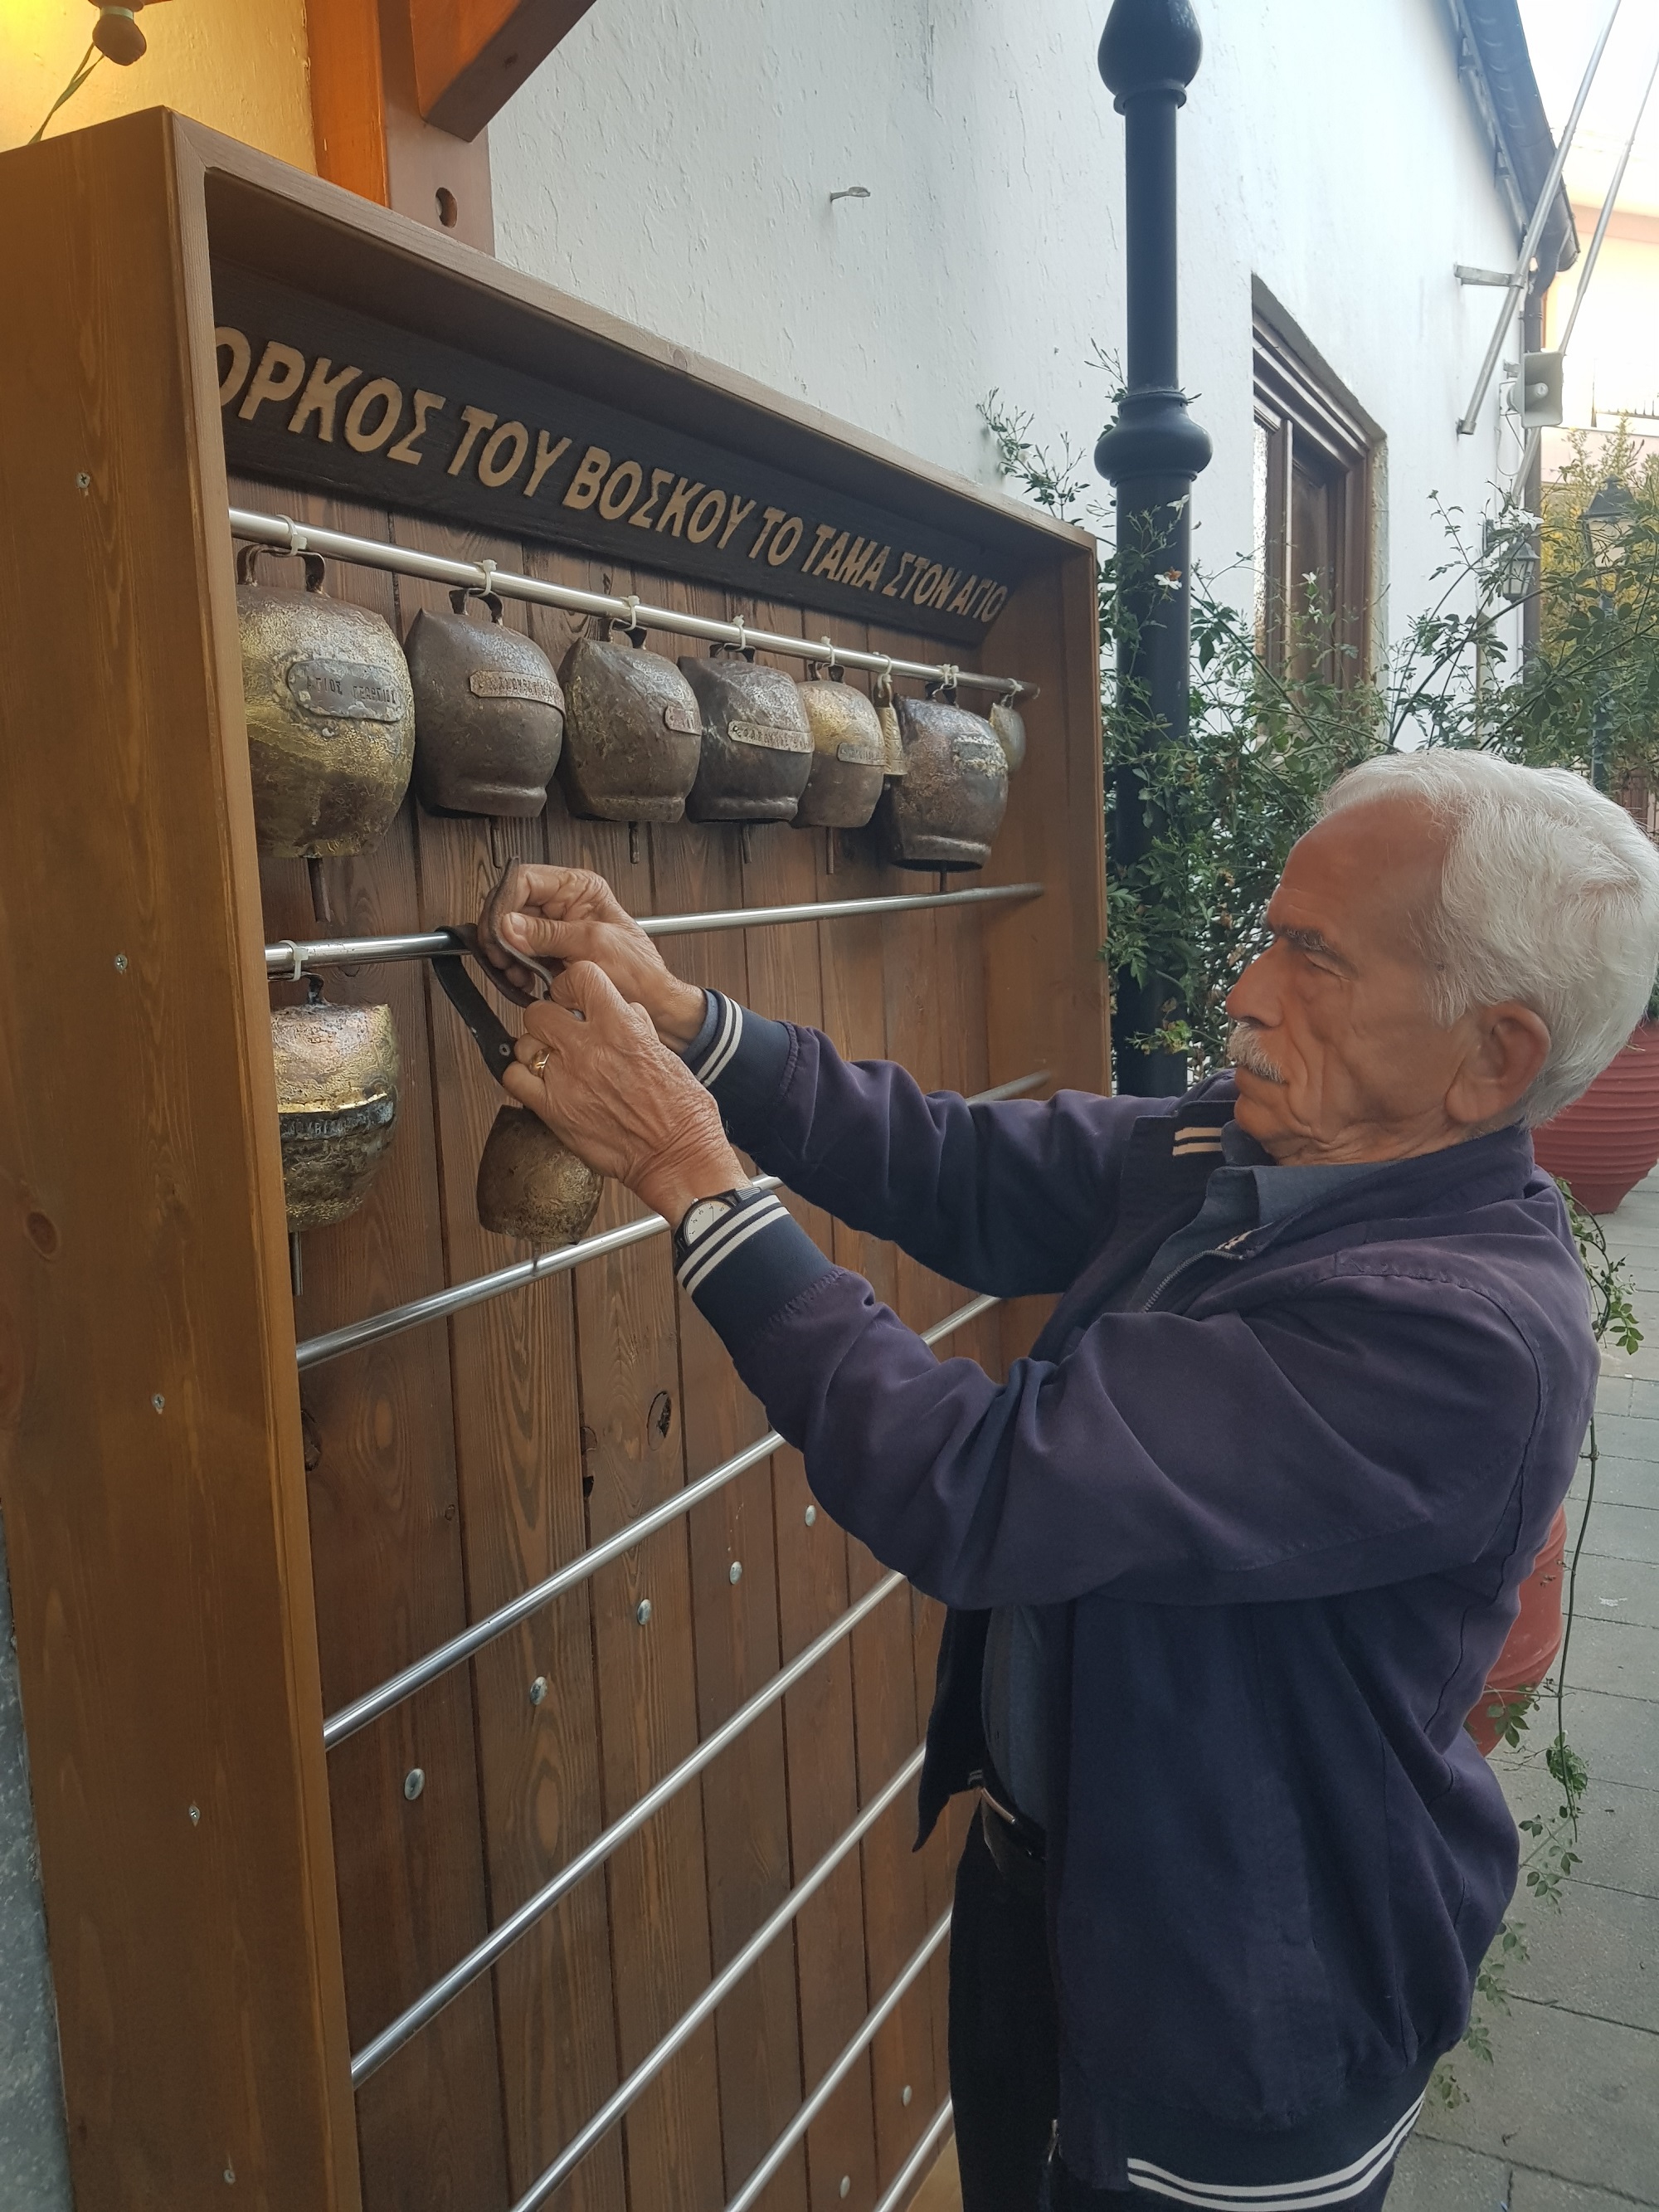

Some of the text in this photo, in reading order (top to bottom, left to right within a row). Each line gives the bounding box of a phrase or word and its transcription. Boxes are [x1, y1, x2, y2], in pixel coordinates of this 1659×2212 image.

[214, 326, 1009, 623] ΟΡΚΟΣ ΤΟΥ ΒΟΣΚΟΥ ΤΟ ΤΑΜΑ ΣΤΟΝ ΑΓΙΟ
